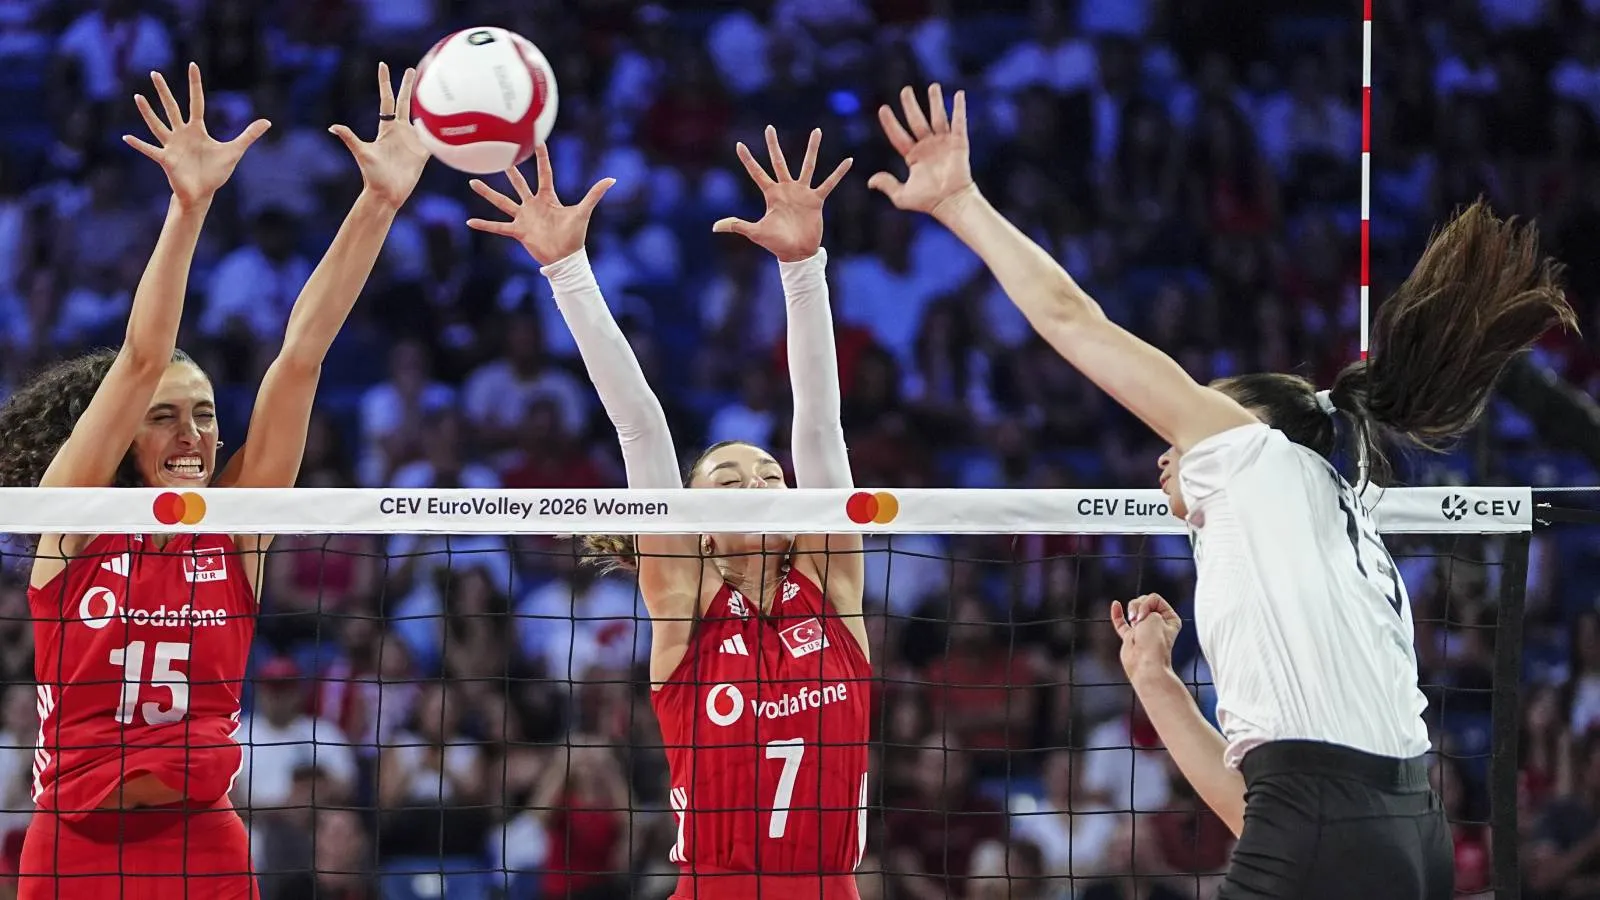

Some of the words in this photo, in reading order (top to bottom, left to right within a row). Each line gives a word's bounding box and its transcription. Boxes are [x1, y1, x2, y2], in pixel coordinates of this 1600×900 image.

[380, 497, 422, 514] CEV
[428, 497, 533, 519] EuroVolley
[540, 498, 587, 515] 2026
[594, 498, 669, 515] Women
[1077, 498, 1119, 515] CEV
[1124, 499, 1169, 516] Euro
[1474, 500, 1521, 516] CEV
[194, 572, 217, 580] TUR
[118, 605, 227, 627] vodafone
[800, 641, 820, 653] TUR
[109, 640, 190, 725] 15
[751, 683, 847, 719] vodafone
[765, 737, 805, 839] 7
